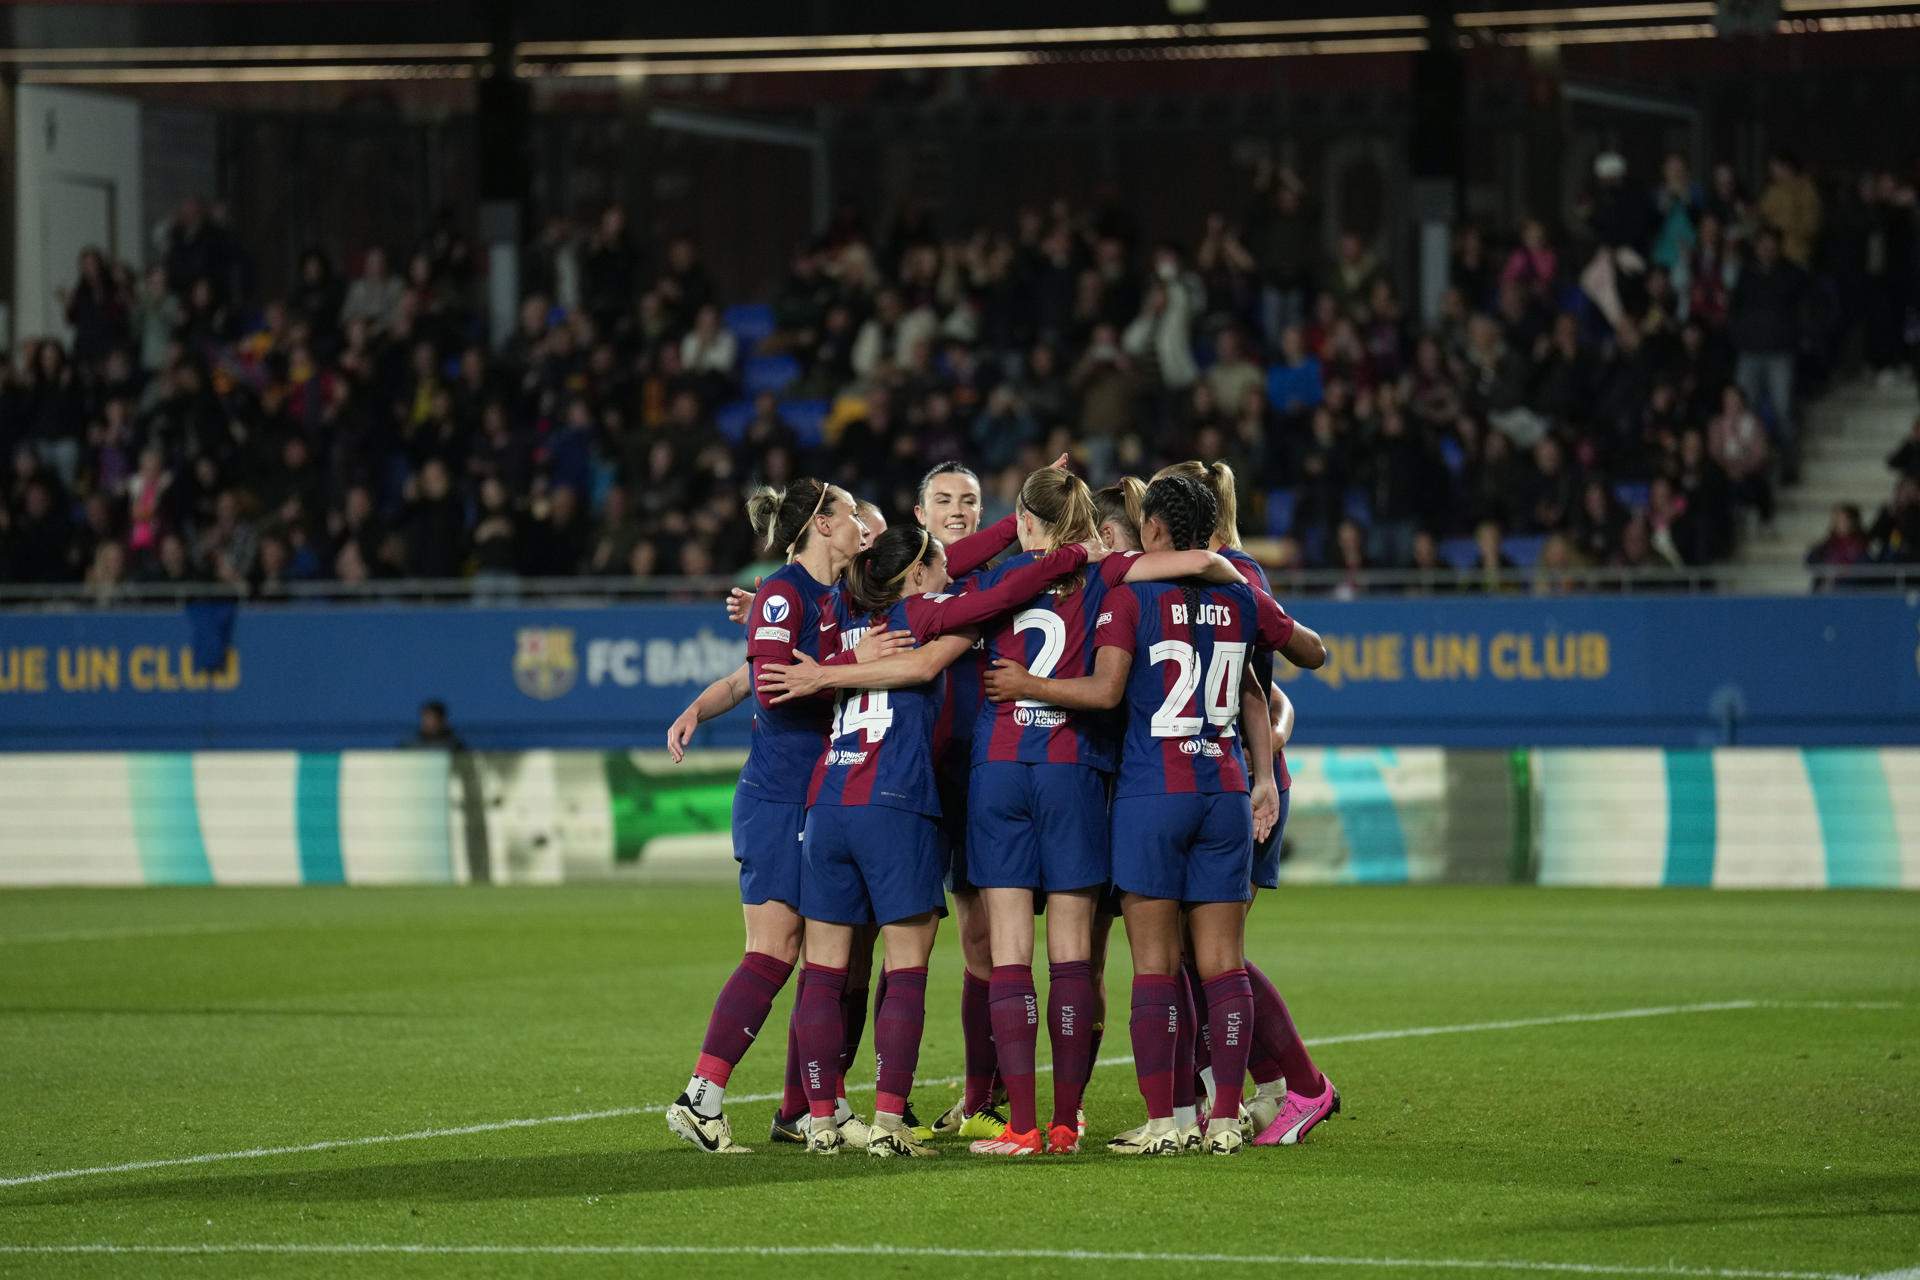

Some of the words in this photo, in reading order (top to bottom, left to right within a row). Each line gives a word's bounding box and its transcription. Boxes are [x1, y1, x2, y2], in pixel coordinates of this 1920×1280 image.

[57, 645, 119, 691] UN
[587, 638, 641, 685] FC
[1013, 608, 1066, 707] 2
[1412, 634, 1479, 680] UN
[1490, 633, 1610, 680] CLUB
[1149, 640, 1247, 737] 24
[1226, 1012, 1243, 1045] BARÇA
[808, 1060, 822, 1089] BARÇA
